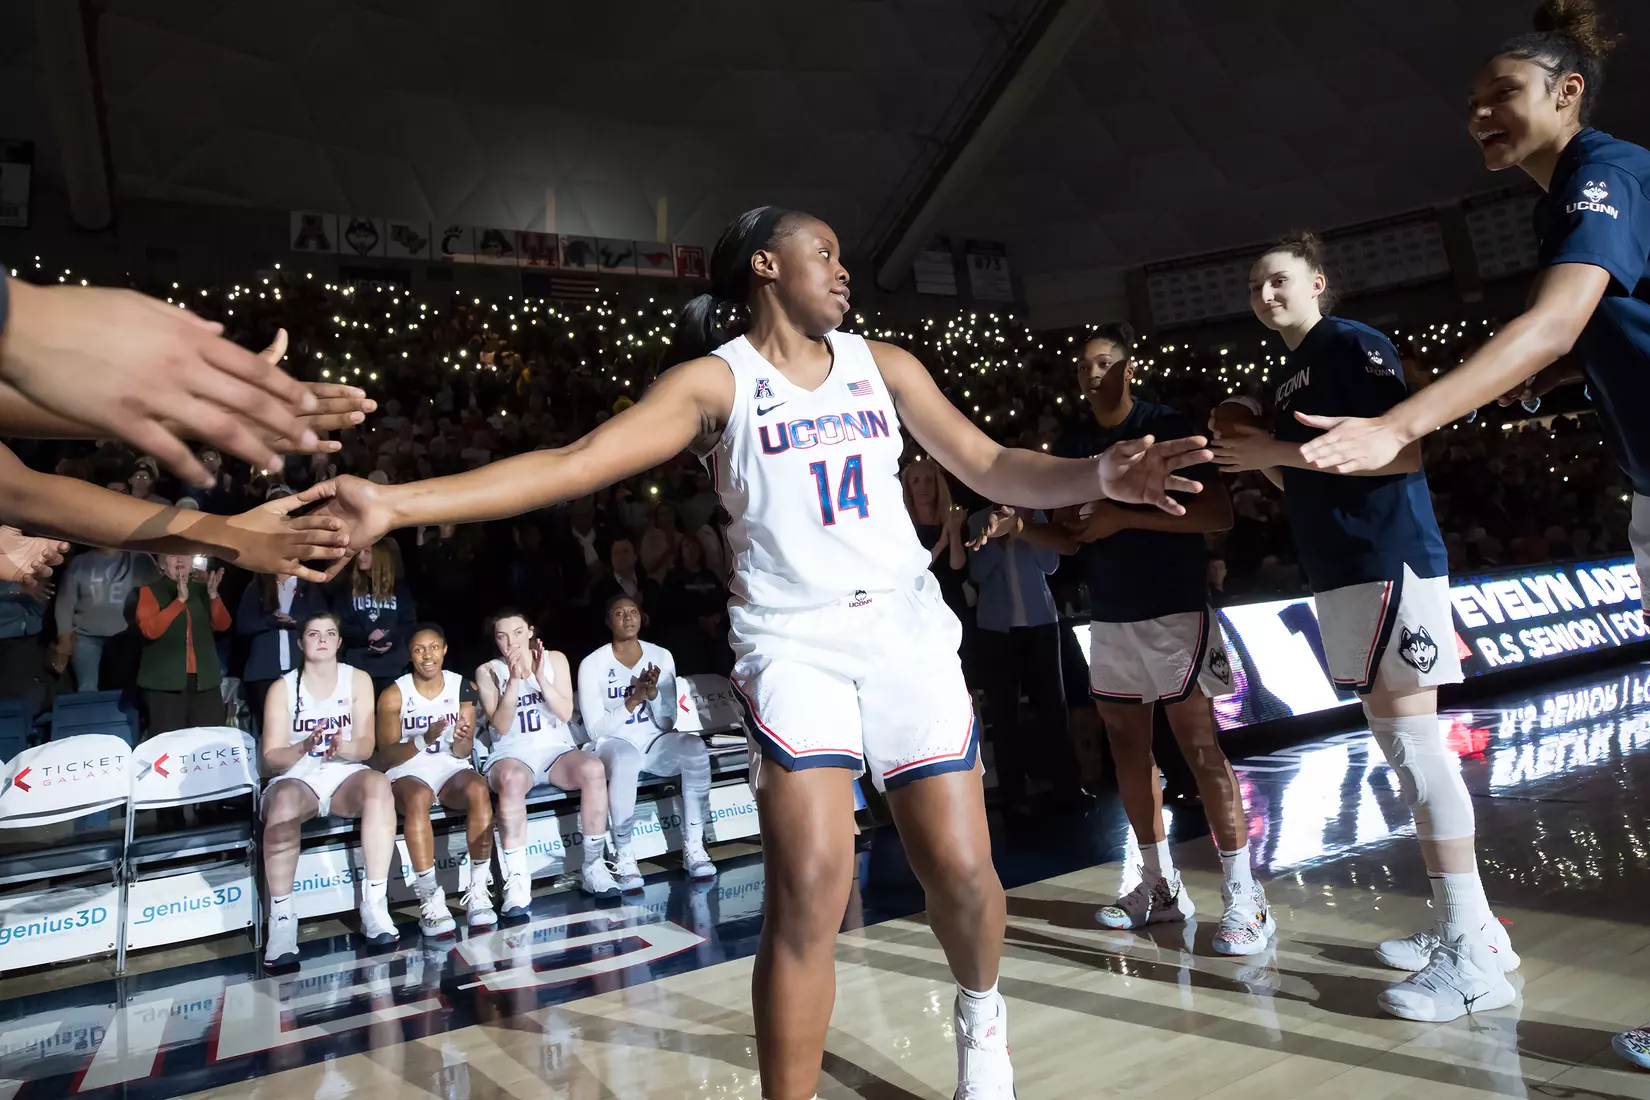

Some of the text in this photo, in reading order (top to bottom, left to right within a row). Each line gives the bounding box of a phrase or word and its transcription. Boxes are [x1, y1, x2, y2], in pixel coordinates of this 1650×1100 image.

[1566, 201, 1619, 219] UCONN
[758, 410, 889, 455] UCONN
[809, 454, 870, 526] 14
[848, 598, 873, 608] UCONN
[1450, 563, 1642, 629] EVELYN ADE
[1475, 632, 1525, 668] R.S
[1519, 617, 1608, 659] SENIOR
[692, 691, 734, 703] TICKE
[293, 714, 352, 732] UCONN
[404, 713, 459, 730] UCN
[517, 709, 541, 733] 10
[42, 755, 124, 777] TICKET
[179, 746, 253, 764] TICKET
[42, 766, 123, 787] GALAXY
[632, 813, 681, 837] nius3D
[704, 804, 758, 823] genius
[525, 831, 584, 857] nius3D
[292, 866, 366, 892] enius3D
[136, 886, 242, 925] genius3D
[0, 906, 107, 946] genius3D
